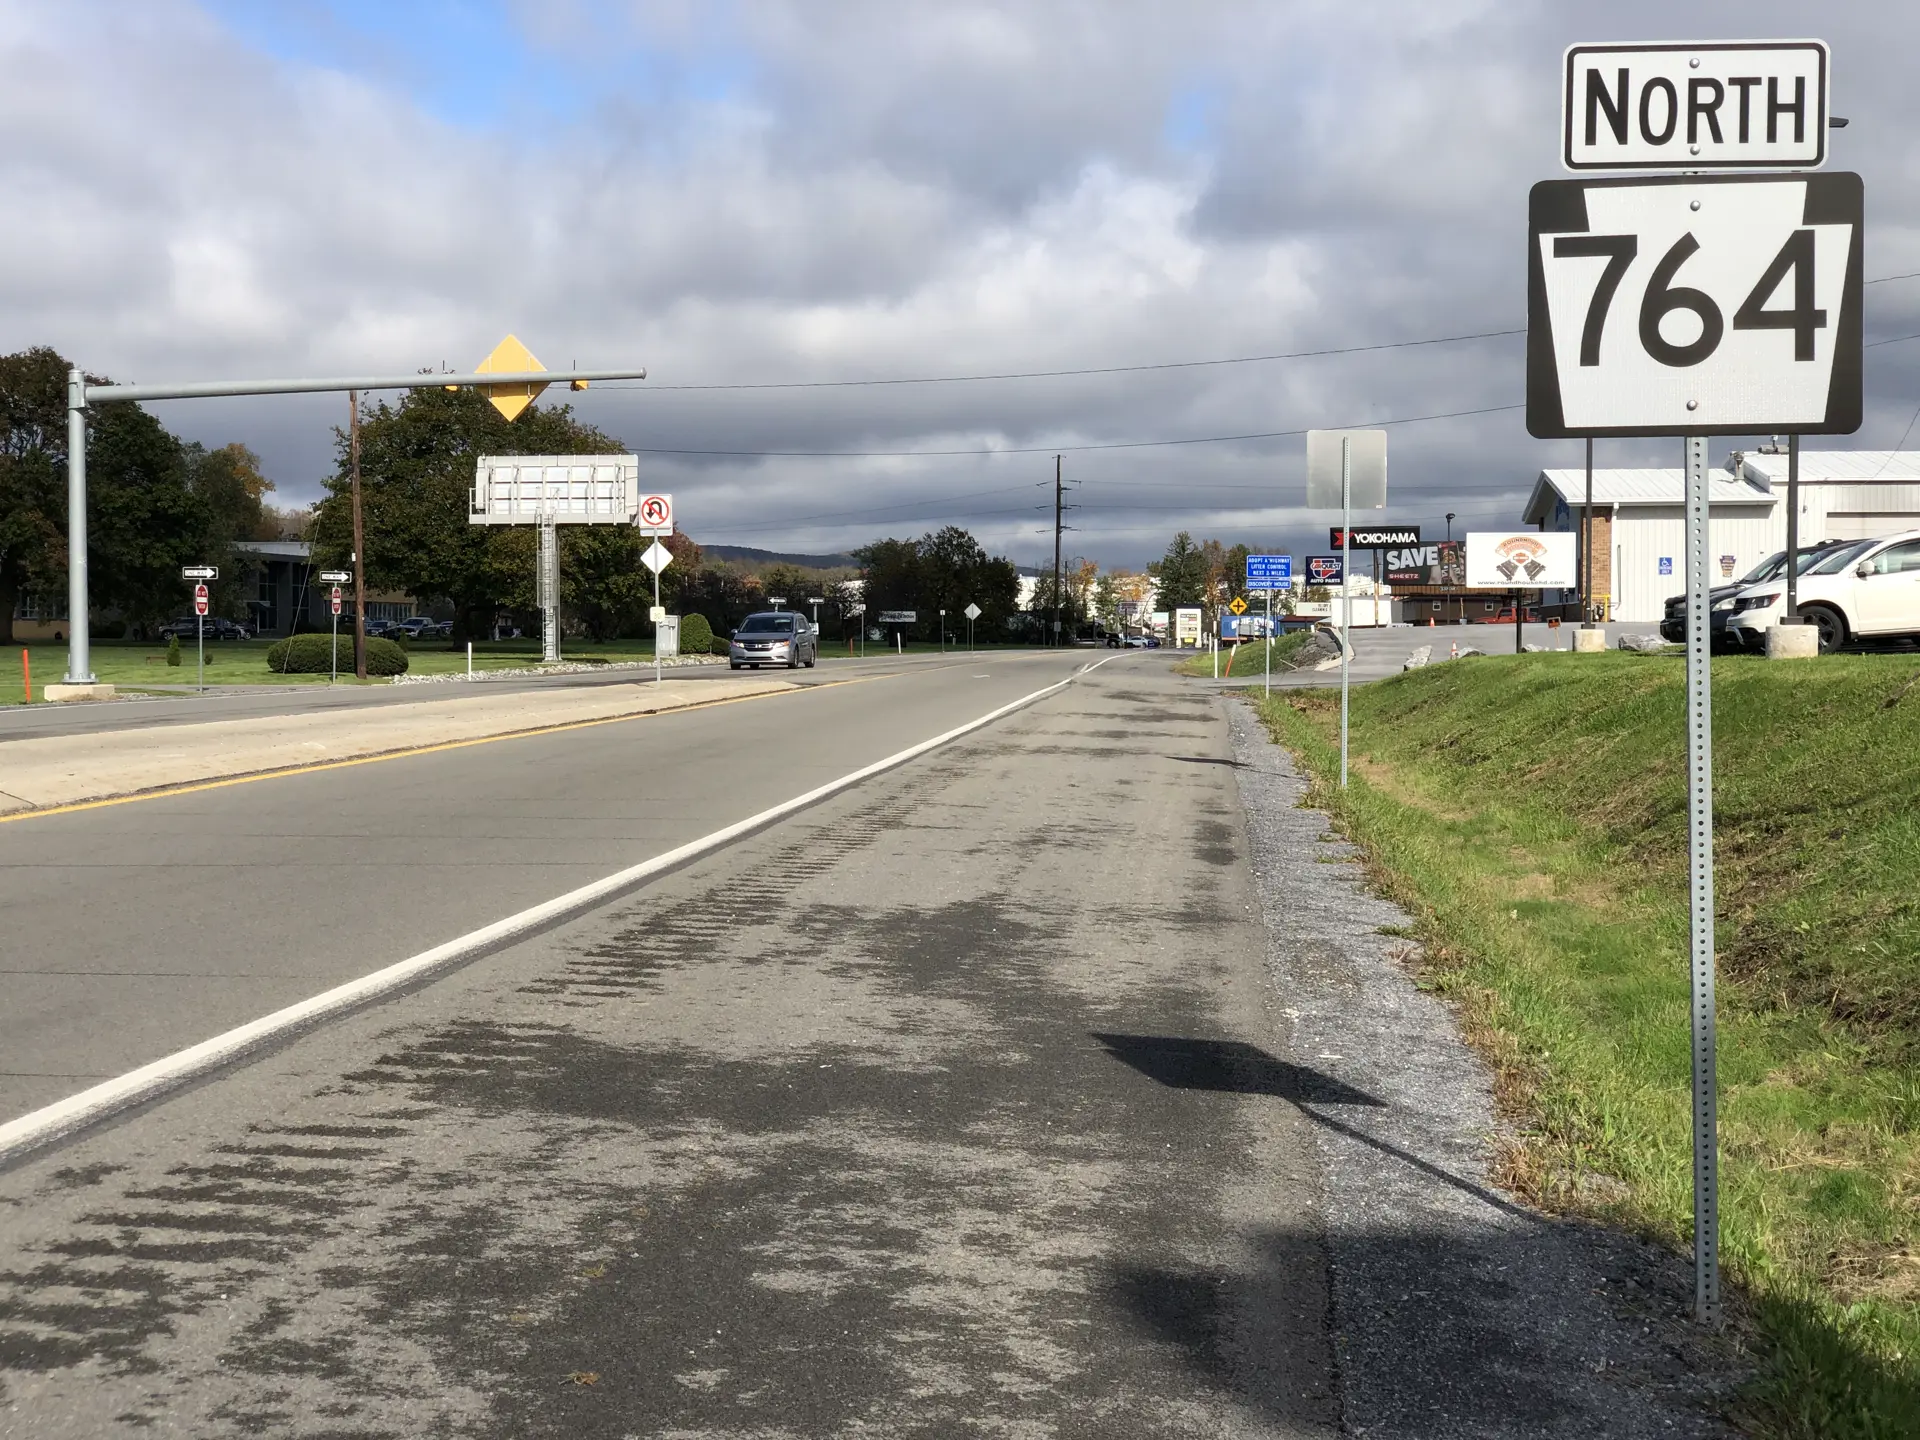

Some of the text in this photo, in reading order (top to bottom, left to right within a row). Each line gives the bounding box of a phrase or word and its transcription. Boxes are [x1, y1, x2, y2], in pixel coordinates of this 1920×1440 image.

[1584, 67, 1806, 146] NORTH
[1553, 229, 1828, 368] 764
[1354, 532, 1418, 544] YOKOHAMA
[1311, 562, 1341, 570] CARQUEST
[1386, 546, 1439, 571] SAVE
